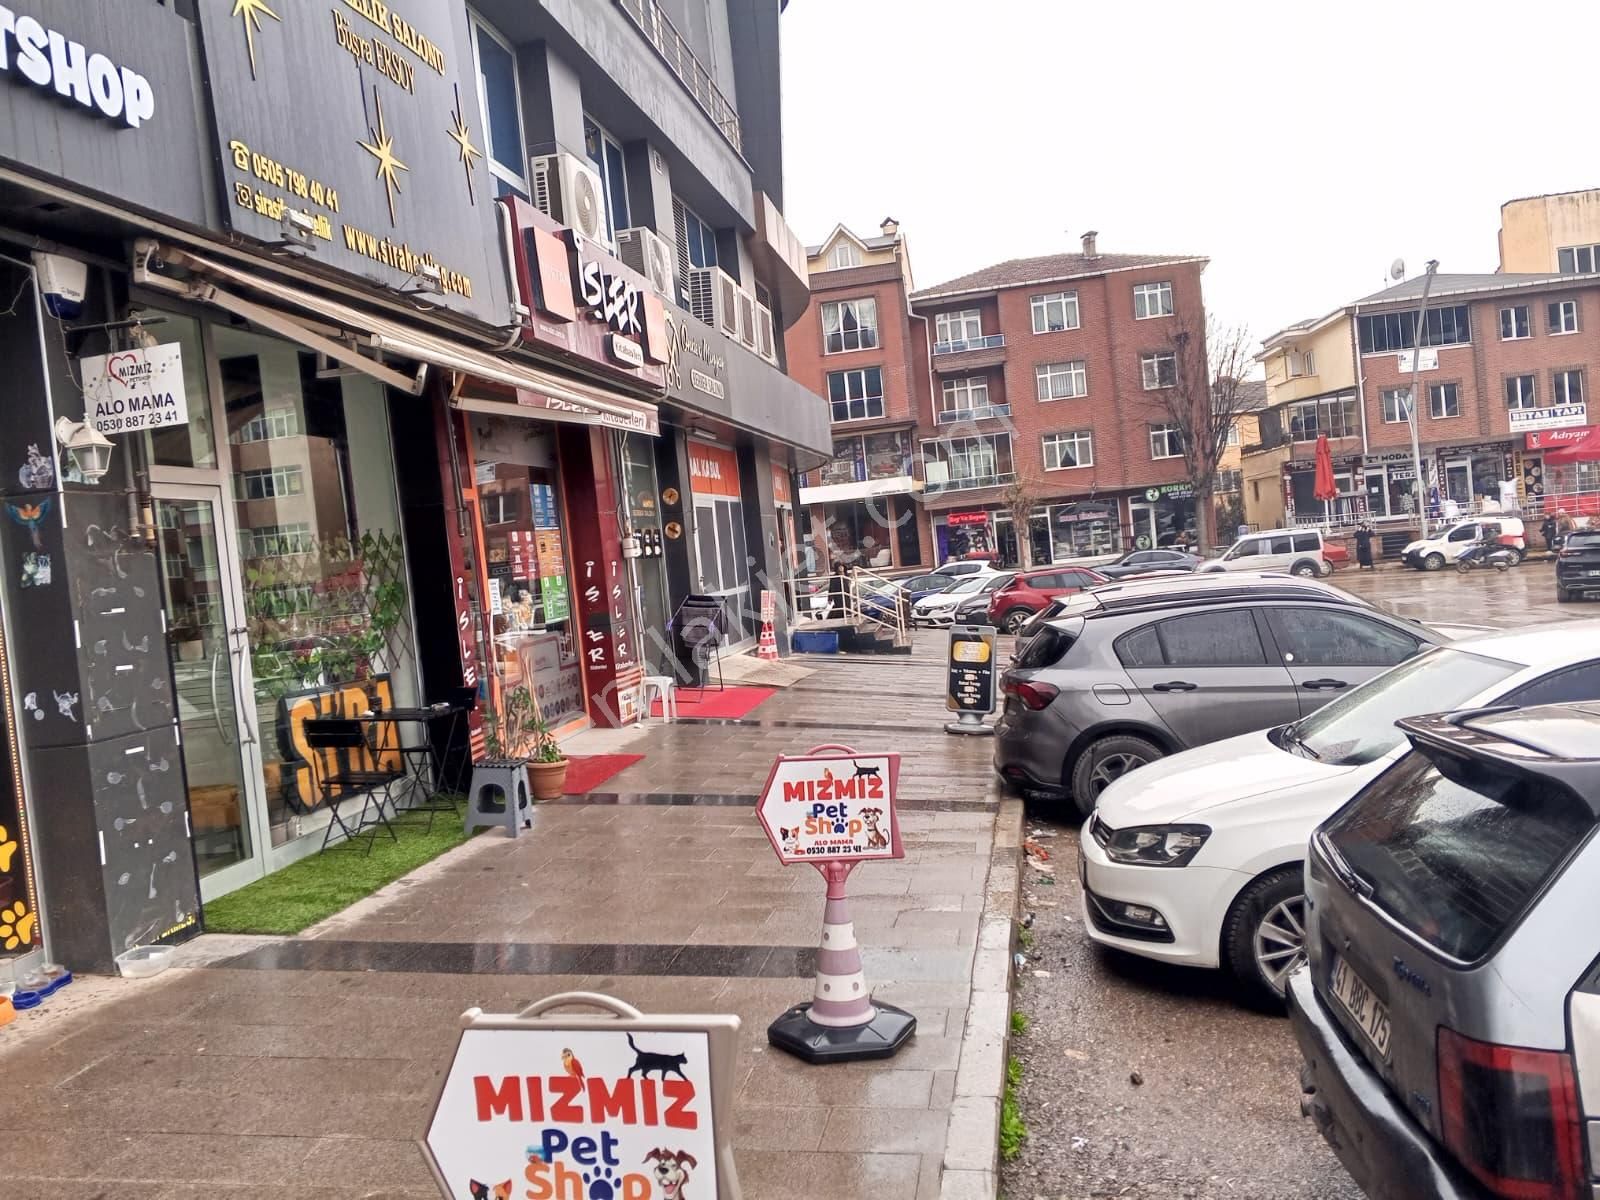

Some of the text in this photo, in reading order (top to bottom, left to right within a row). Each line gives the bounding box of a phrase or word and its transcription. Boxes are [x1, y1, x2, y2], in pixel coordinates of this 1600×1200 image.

[371, 38, 415, 95] ERSOY
[252, 152, 339, 213] 0505 798 40 41
[95, 392, 175, 417] ALO MAMA
[96, 410, 178, 433] 0530 887 23 41
[783, 777, 884, 802] MIZMIZ
[812, 802, 848, 818] Pet
[1348, 975, 1369, 1023] BBC
[1369, 1001, 1391, 1049] 175
[473, 1075, 698, 1130] MIZMIZ
[541, 1128, 620, 1166] Pet
